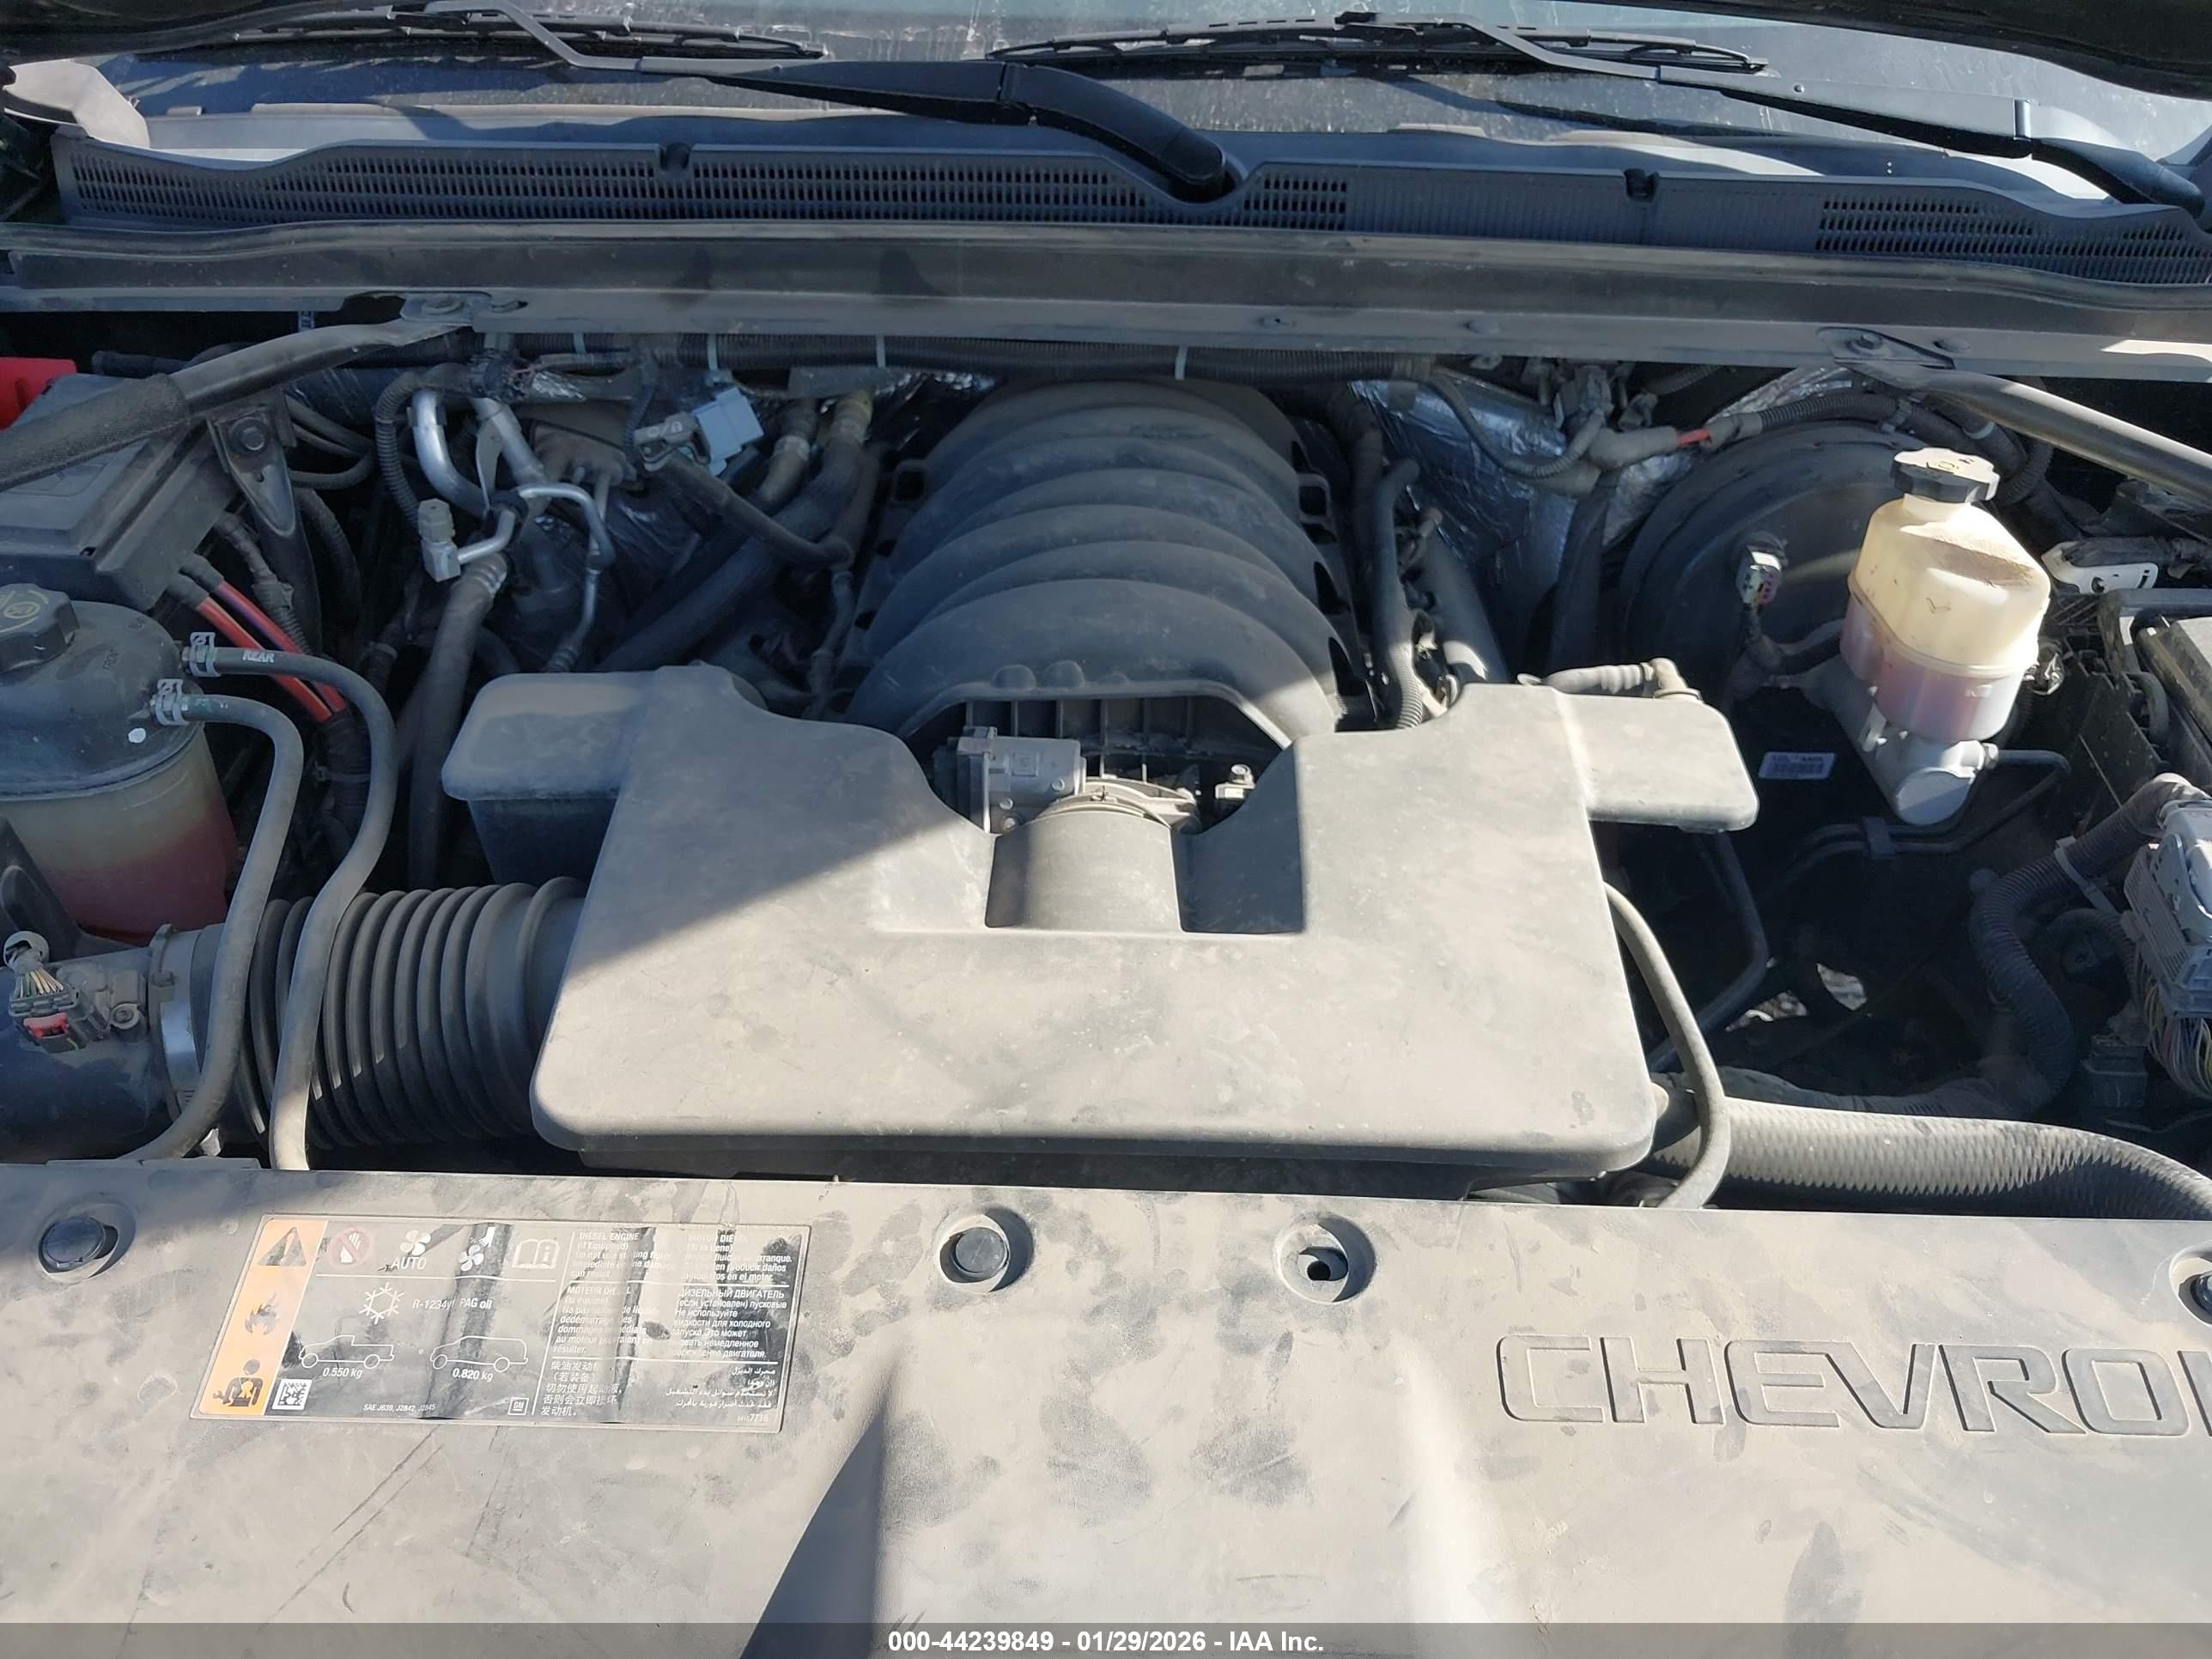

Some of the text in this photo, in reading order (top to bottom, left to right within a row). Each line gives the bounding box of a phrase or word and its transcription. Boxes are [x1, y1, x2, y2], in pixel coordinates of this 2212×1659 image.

[242, 649, 274, 663] REAR
[579, 1231, 640, 1241] DIESEL ENGINE
[391, 1256, 427, 1271] AUTO
[733, 1289, 785, 1299] ДВИГАТЕЛЬ
[412, 1297, 492, 1310] R-1234yf PAG oil
[750, 1301, 787, 1310] пусковые
[675, 1308, 738, 1319] Не используйте
[712, 1320, 727, 1328] для
[728, 1320, 771, 1328] холодного
[720, 1329, 748, 1338] может
[322, 1366, 364, 1379] 0.550 kg
[452, 1367, 494, 1382] 0.820 kg
